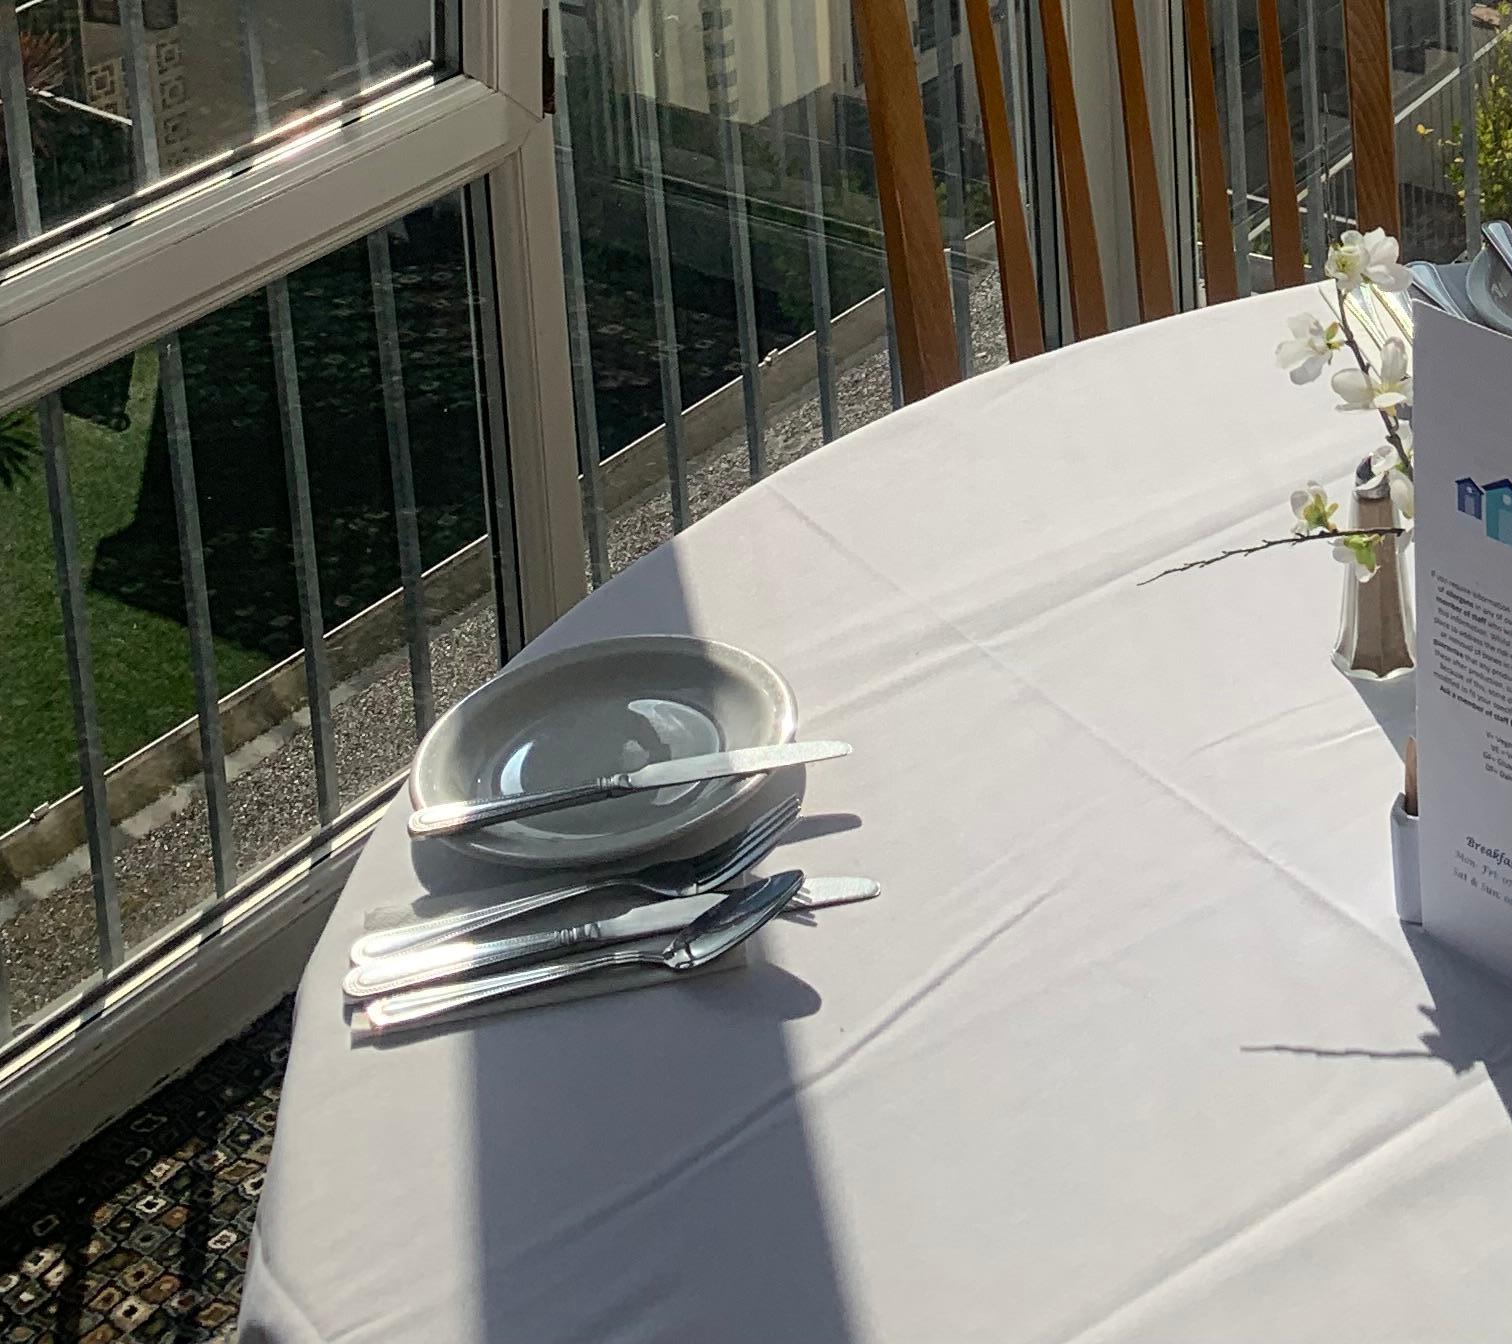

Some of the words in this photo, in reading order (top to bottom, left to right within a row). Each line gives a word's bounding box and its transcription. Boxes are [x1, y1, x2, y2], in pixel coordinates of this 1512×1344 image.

[1437, 575, 1448, 584] you
[1447, 581, 1471, 596] require
[1473, 592, 1510, 613] information
[1446, 590, 1474, 609] allergens
[1436, 596, 1462, 614] member
[1470, 613, 1487, 625] staff
[1486, 619, 1503, 633] who
[1438, 607, 1450, 619] this
[1433, 639, 1464, 659] guarantee
[1463, 654, 1478, 666] that
[1479, 662, 1491, 673] any
[1448, 635, 1474, 653] removal
[1480, 652, 1502, 667] bones
[1459, 631, 1483, 647] address
[1482, 641, 1496, 652] the
[1433, 671, 1460, 690] modified
[1440, 662, 1464, 681] Because
[1488, 689, 1506, 702] some
[1440, 685, 1451, 696] Ask
[1456, 695, 1484, 713] member
[1494, 714, 1509, 725] staff
[1470, 876, 1478, 887] &
